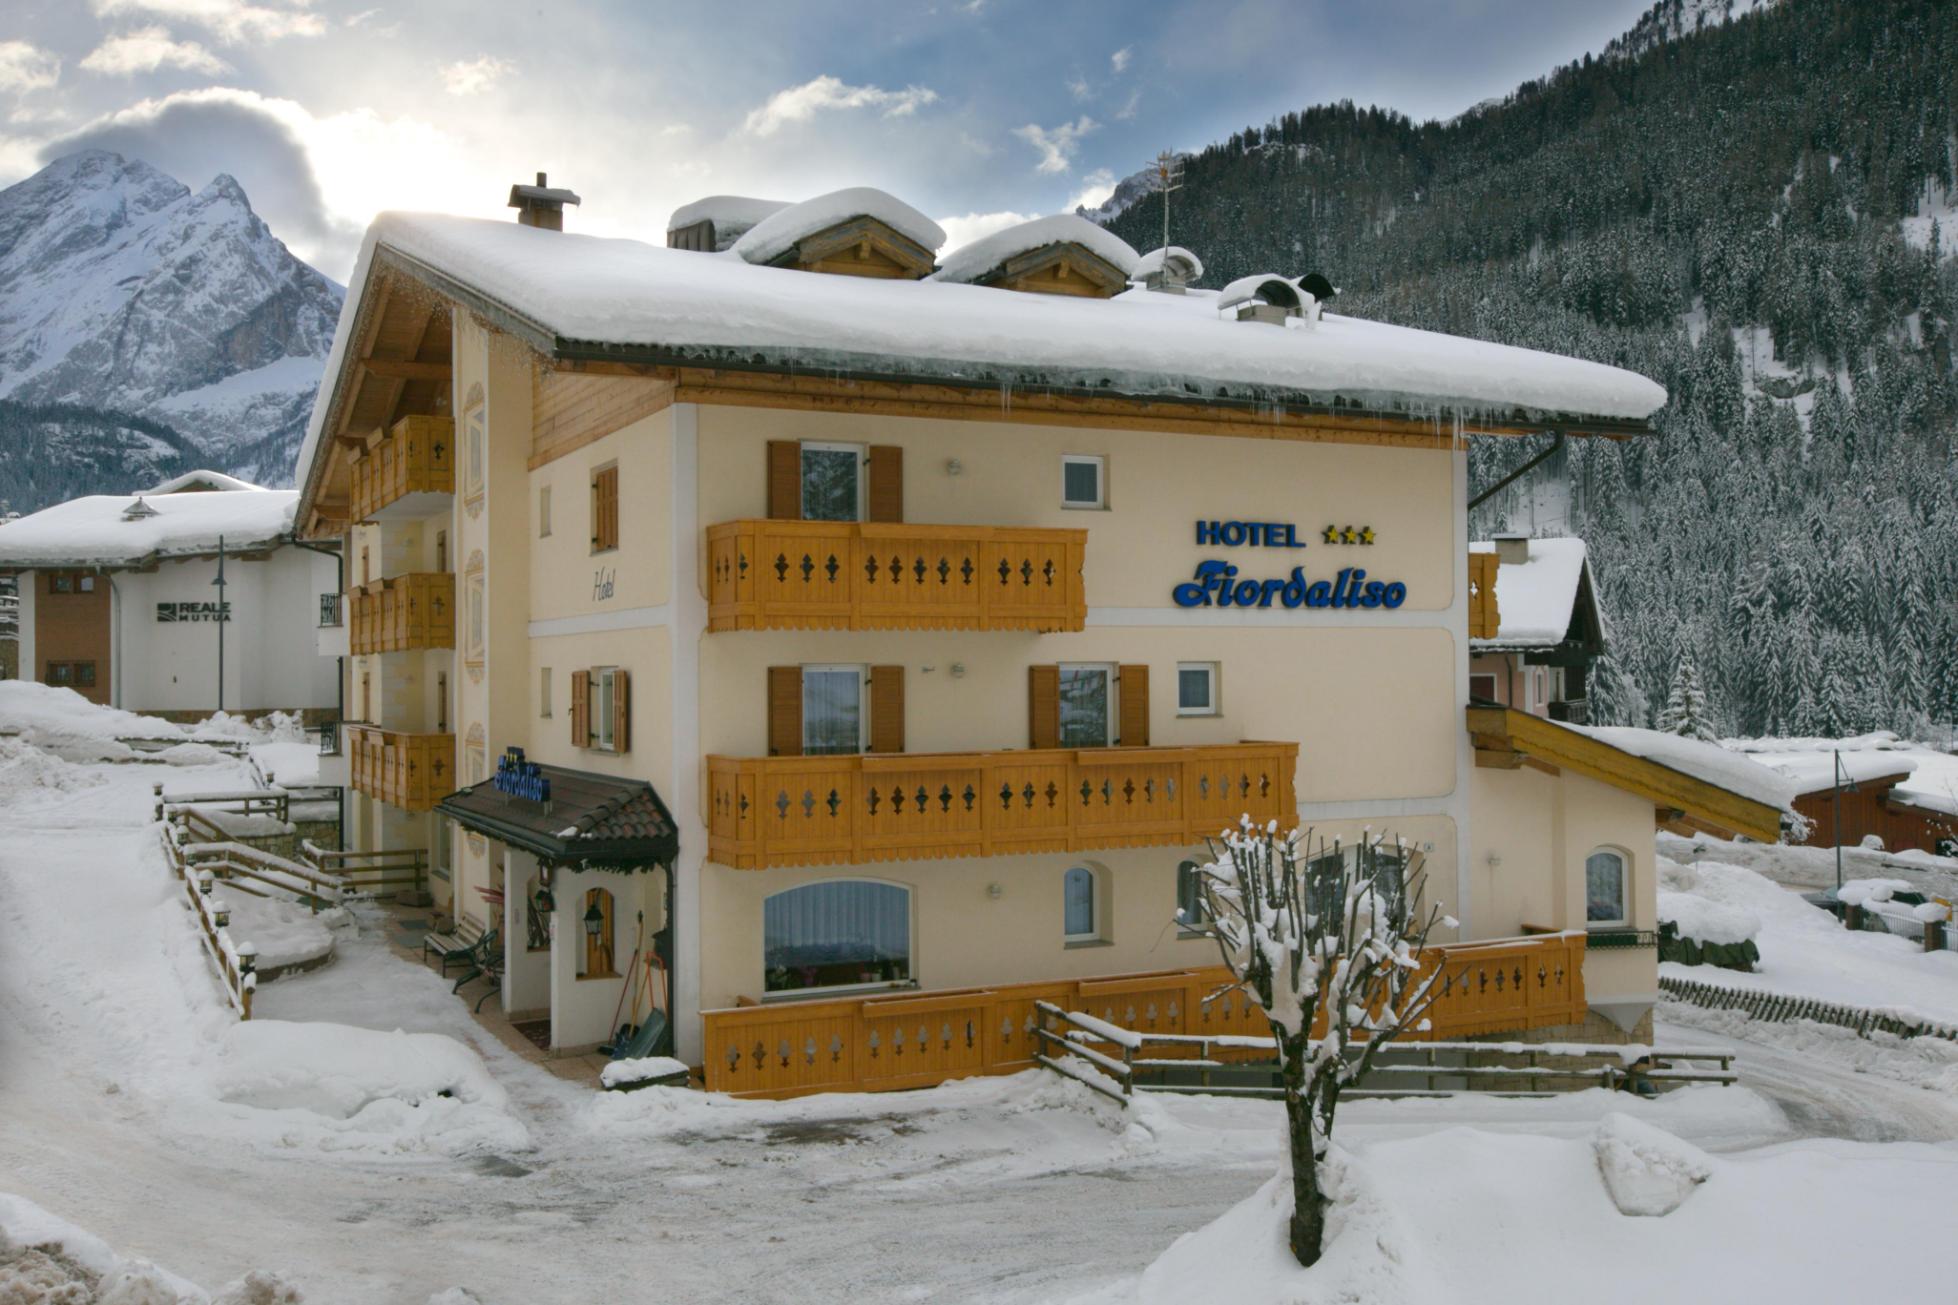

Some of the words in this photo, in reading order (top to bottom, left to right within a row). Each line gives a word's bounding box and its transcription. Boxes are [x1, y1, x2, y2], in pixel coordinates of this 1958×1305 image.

[1196, 520, 1306, 548] HOTEL
[592, 566, 616, 601] Hotel
[1172, 559, 1406, 609] Fiordaliso
[179, 602, 231, 613] REALE
[179, 614, 231, 622] MUTUA
